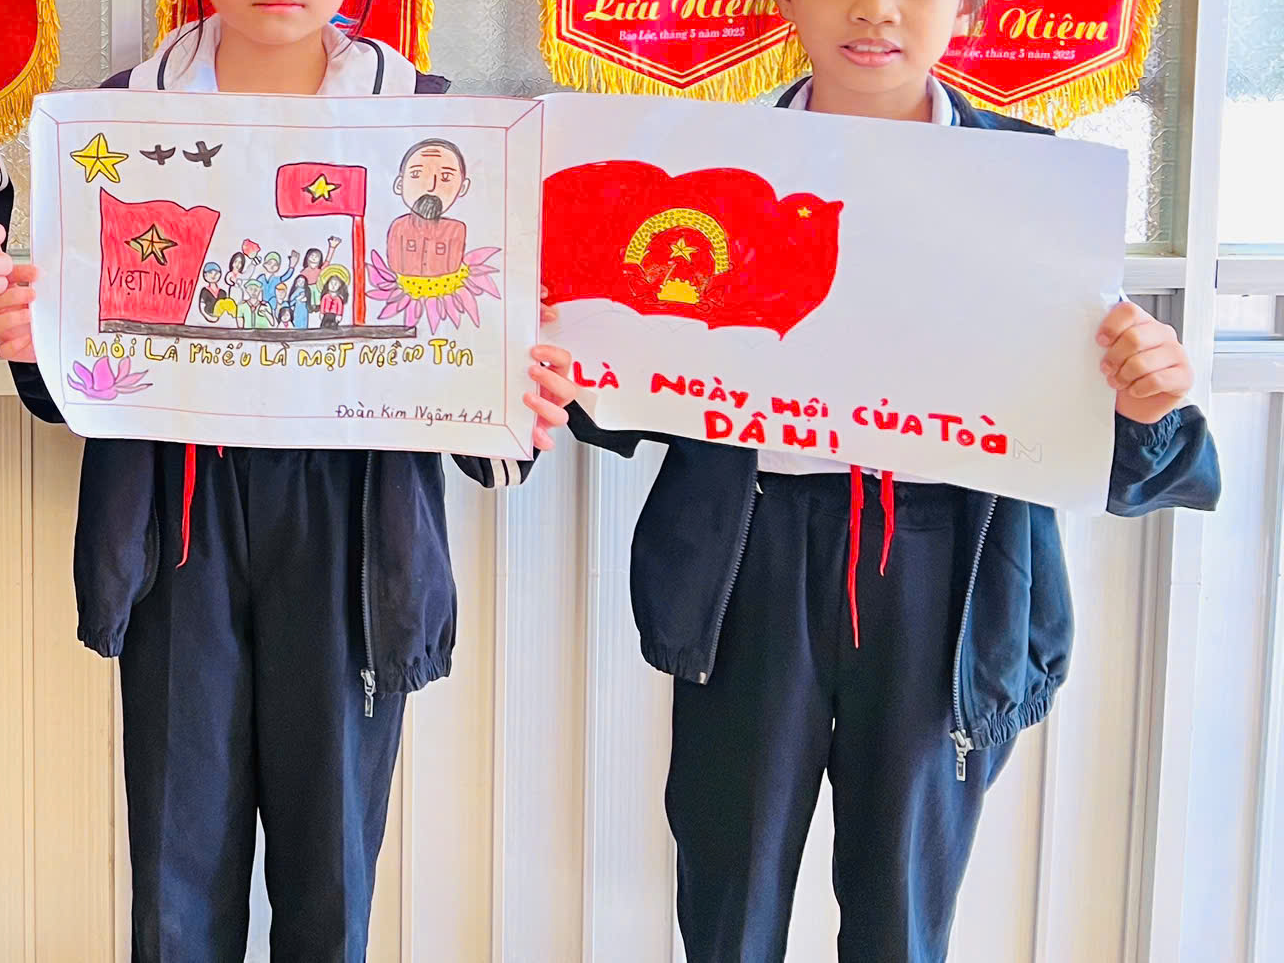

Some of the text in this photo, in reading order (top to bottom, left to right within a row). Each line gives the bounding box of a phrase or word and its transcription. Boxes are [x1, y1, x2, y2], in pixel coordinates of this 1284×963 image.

[721, 27, 745, 38] 2025
[999, 7, 1109, 46] Niệm
[573, 361, 619, 389] LÀ
[335, 401, 374, 418] Đoàn
[381, 404, 406, 418] Kim
[415, 405, 452, 426] Ngân
